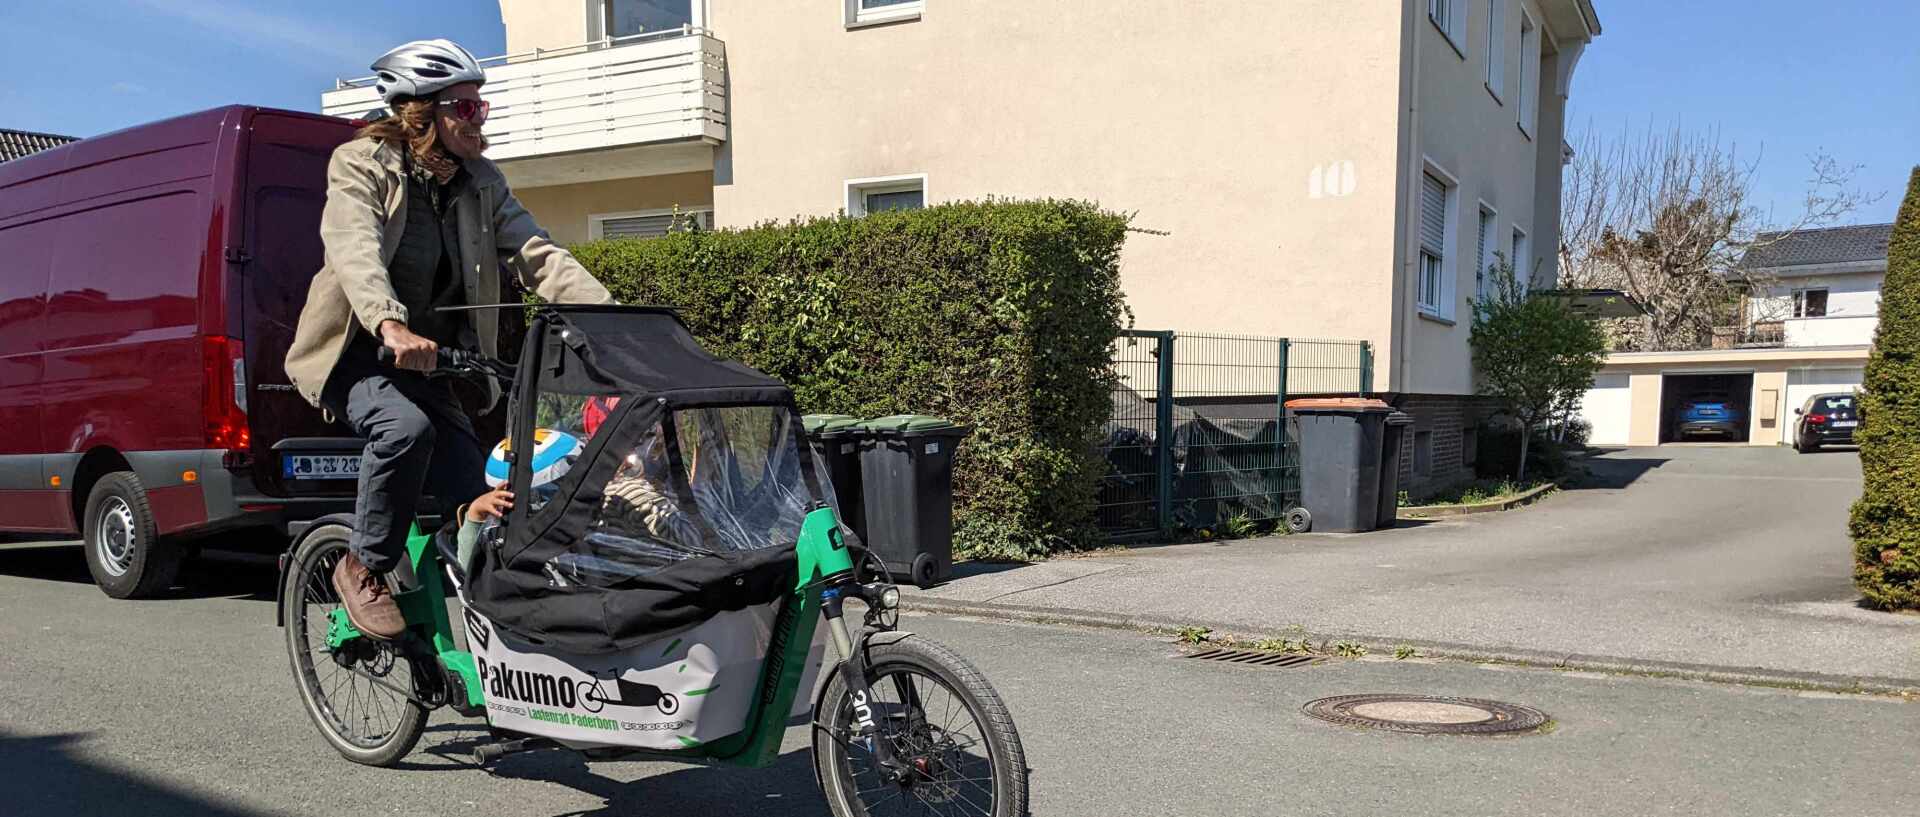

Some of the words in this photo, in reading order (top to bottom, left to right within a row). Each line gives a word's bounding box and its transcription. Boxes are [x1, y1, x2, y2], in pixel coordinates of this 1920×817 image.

[478, 656, 576, 708] Pakumo
[528, 706, 570, 724] Lastenrad
[571, 713, 619, 731] Paderborn
